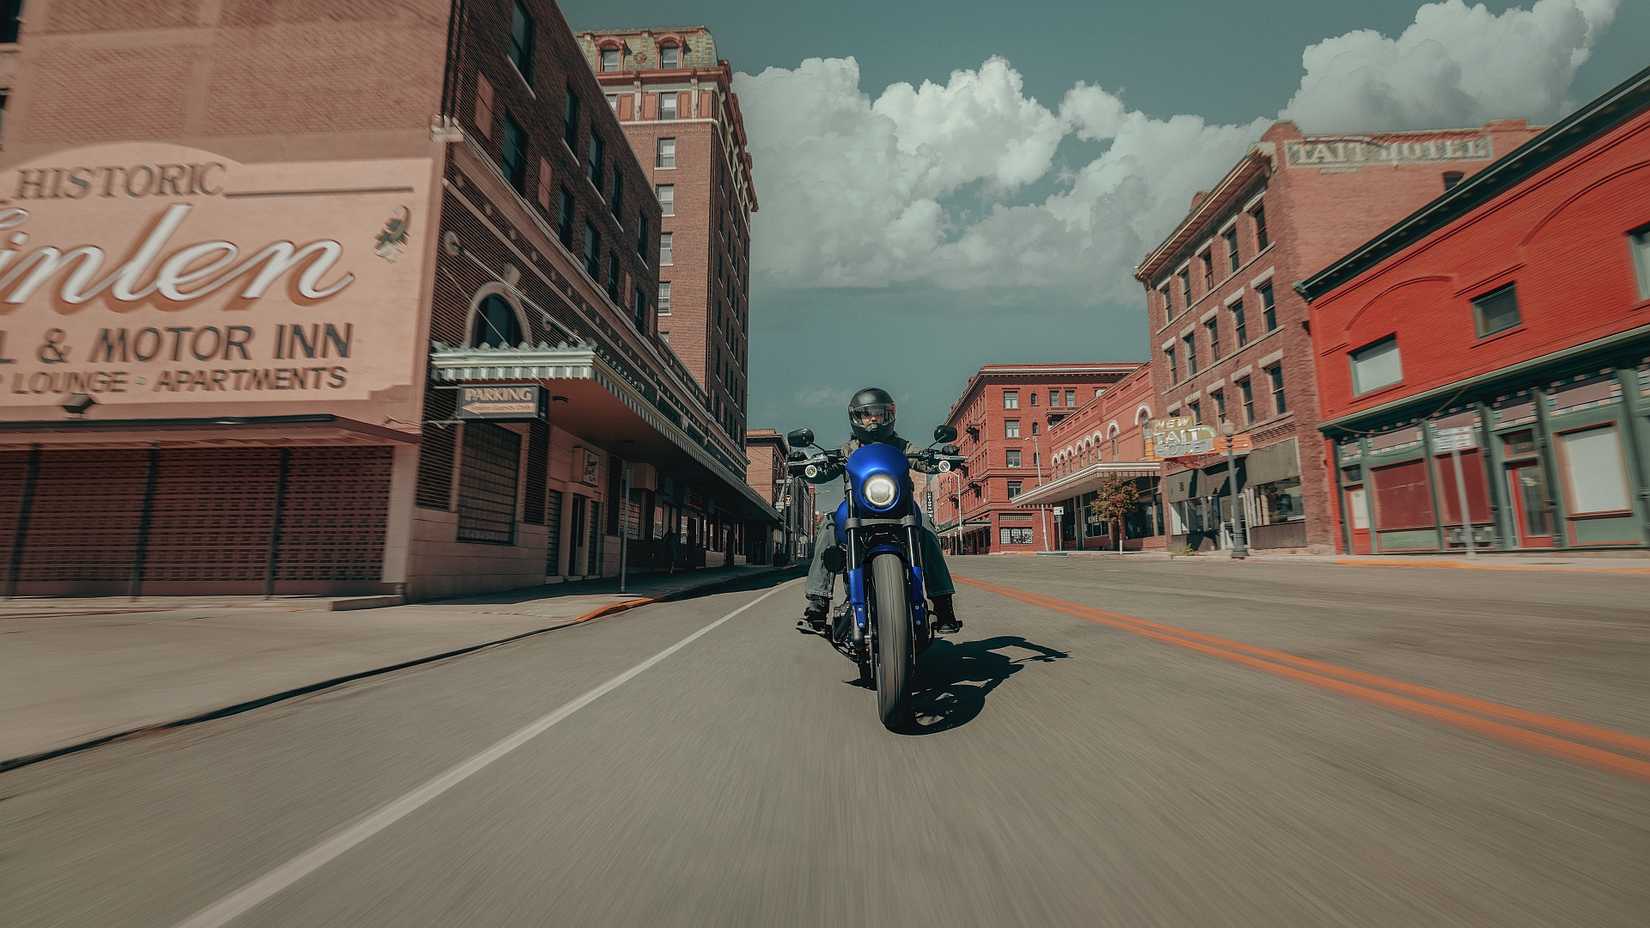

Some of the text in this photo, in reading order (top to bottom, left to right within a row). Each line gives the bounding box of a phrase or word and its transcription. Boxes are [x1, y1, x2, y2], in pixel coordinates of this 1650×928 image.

[12, 162, 226, 199] HISTORIC
[37, 328, 72, 364] &
[87, 325, 254, 362] MOTOR
[272, 322, 353, 359] INN
[11, 371, 128, 394] LOUNGE
[152, 366, 347, 392] APARTMENTS
[464, 387, 533, 401] PARKING
[1153, 427, 1201, 446] TAIT
